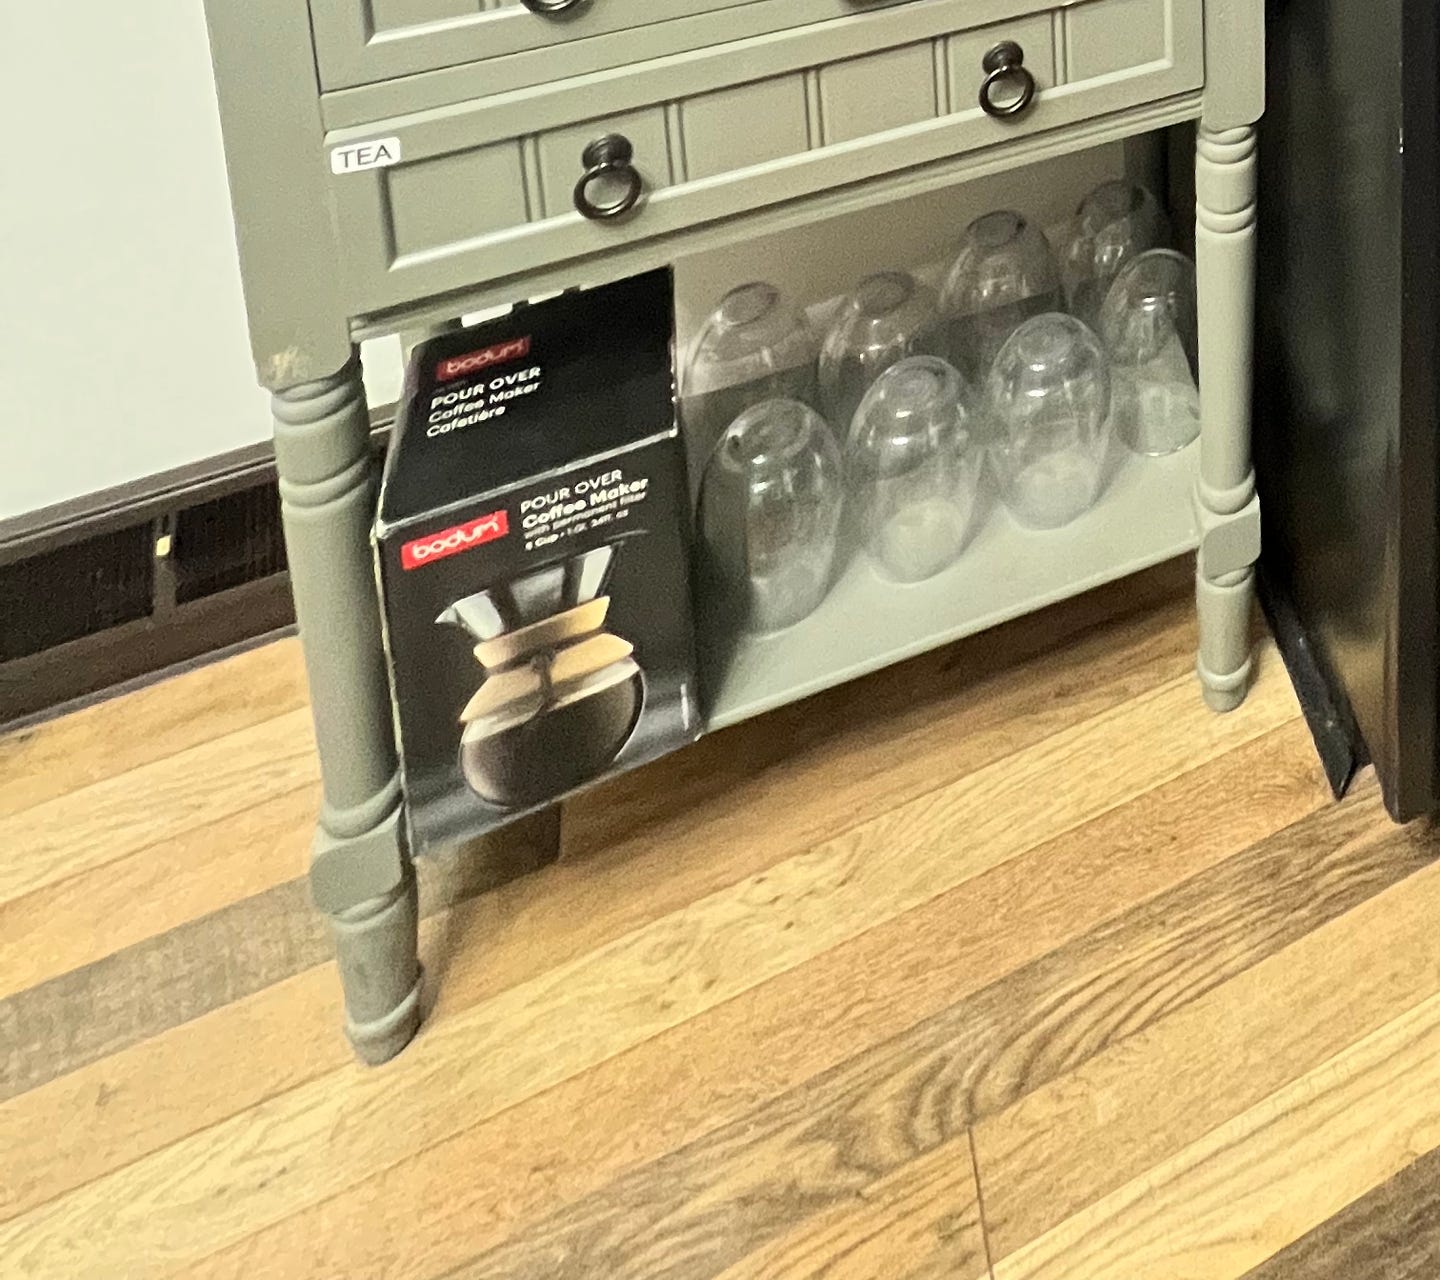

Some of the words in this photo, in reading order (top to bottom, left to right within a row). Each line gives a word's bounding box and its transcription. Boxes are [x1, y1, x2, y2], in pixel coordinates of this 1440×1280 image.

[337, 143, 393, 169] TEA
[446, 338, 526, 375] bodum
[428, 397, 485, 424] Coffee
[489, 381, 541, 404] Maker
[431, 382, 485, 410] POUR
[489, 366, 542, 390] OVER
[520, 488, 571, 514] POUR
[574, 469, 623, 494] OVER
[521, 498, 588, 530] Coffee
[589, 478, 649, 506] Maker
[411, 516, 499, 560] bodum
